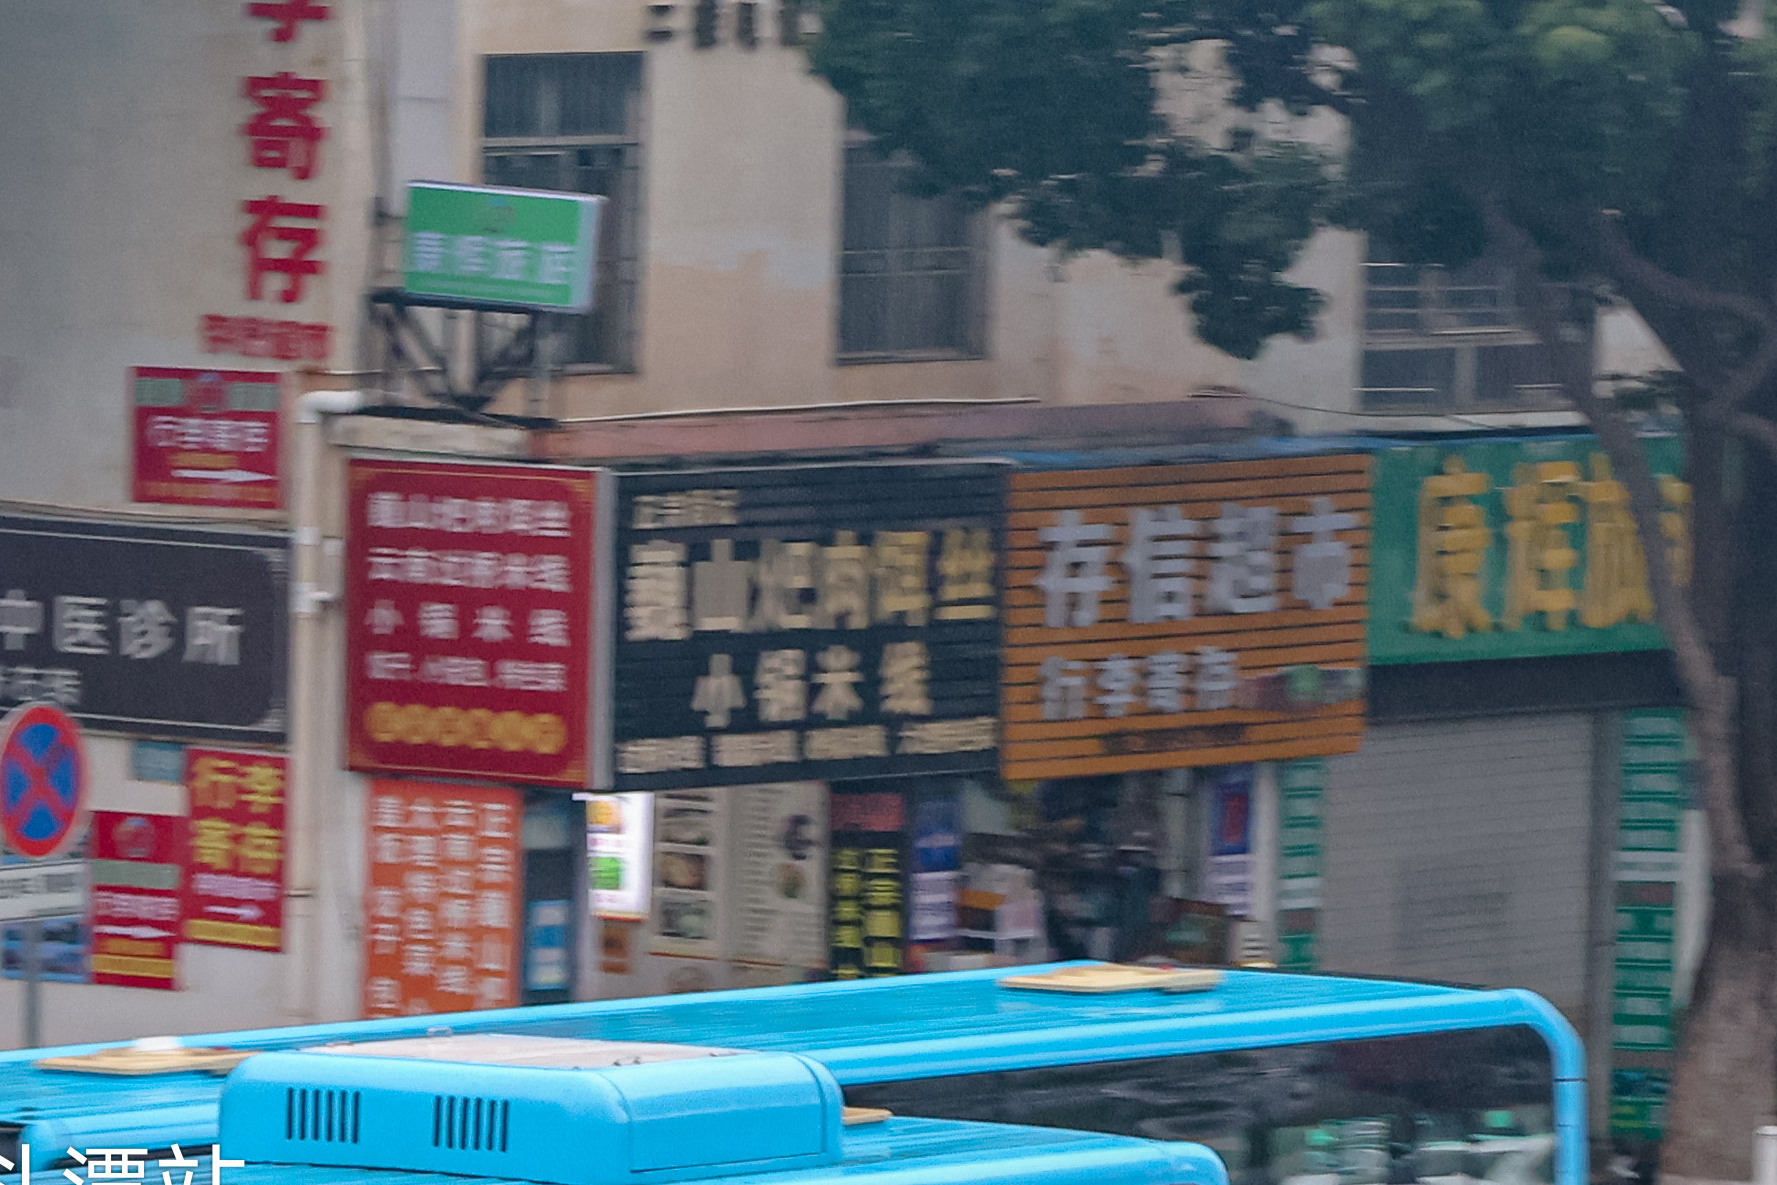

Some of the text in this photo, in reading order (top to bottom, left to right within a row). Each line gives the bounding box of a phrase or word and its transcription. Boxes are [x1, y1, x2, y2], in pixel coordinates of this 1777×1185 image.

[1033, 498, 1362, 629] 存信超市
[1038, 646, 1240, 722] 行李寄存
